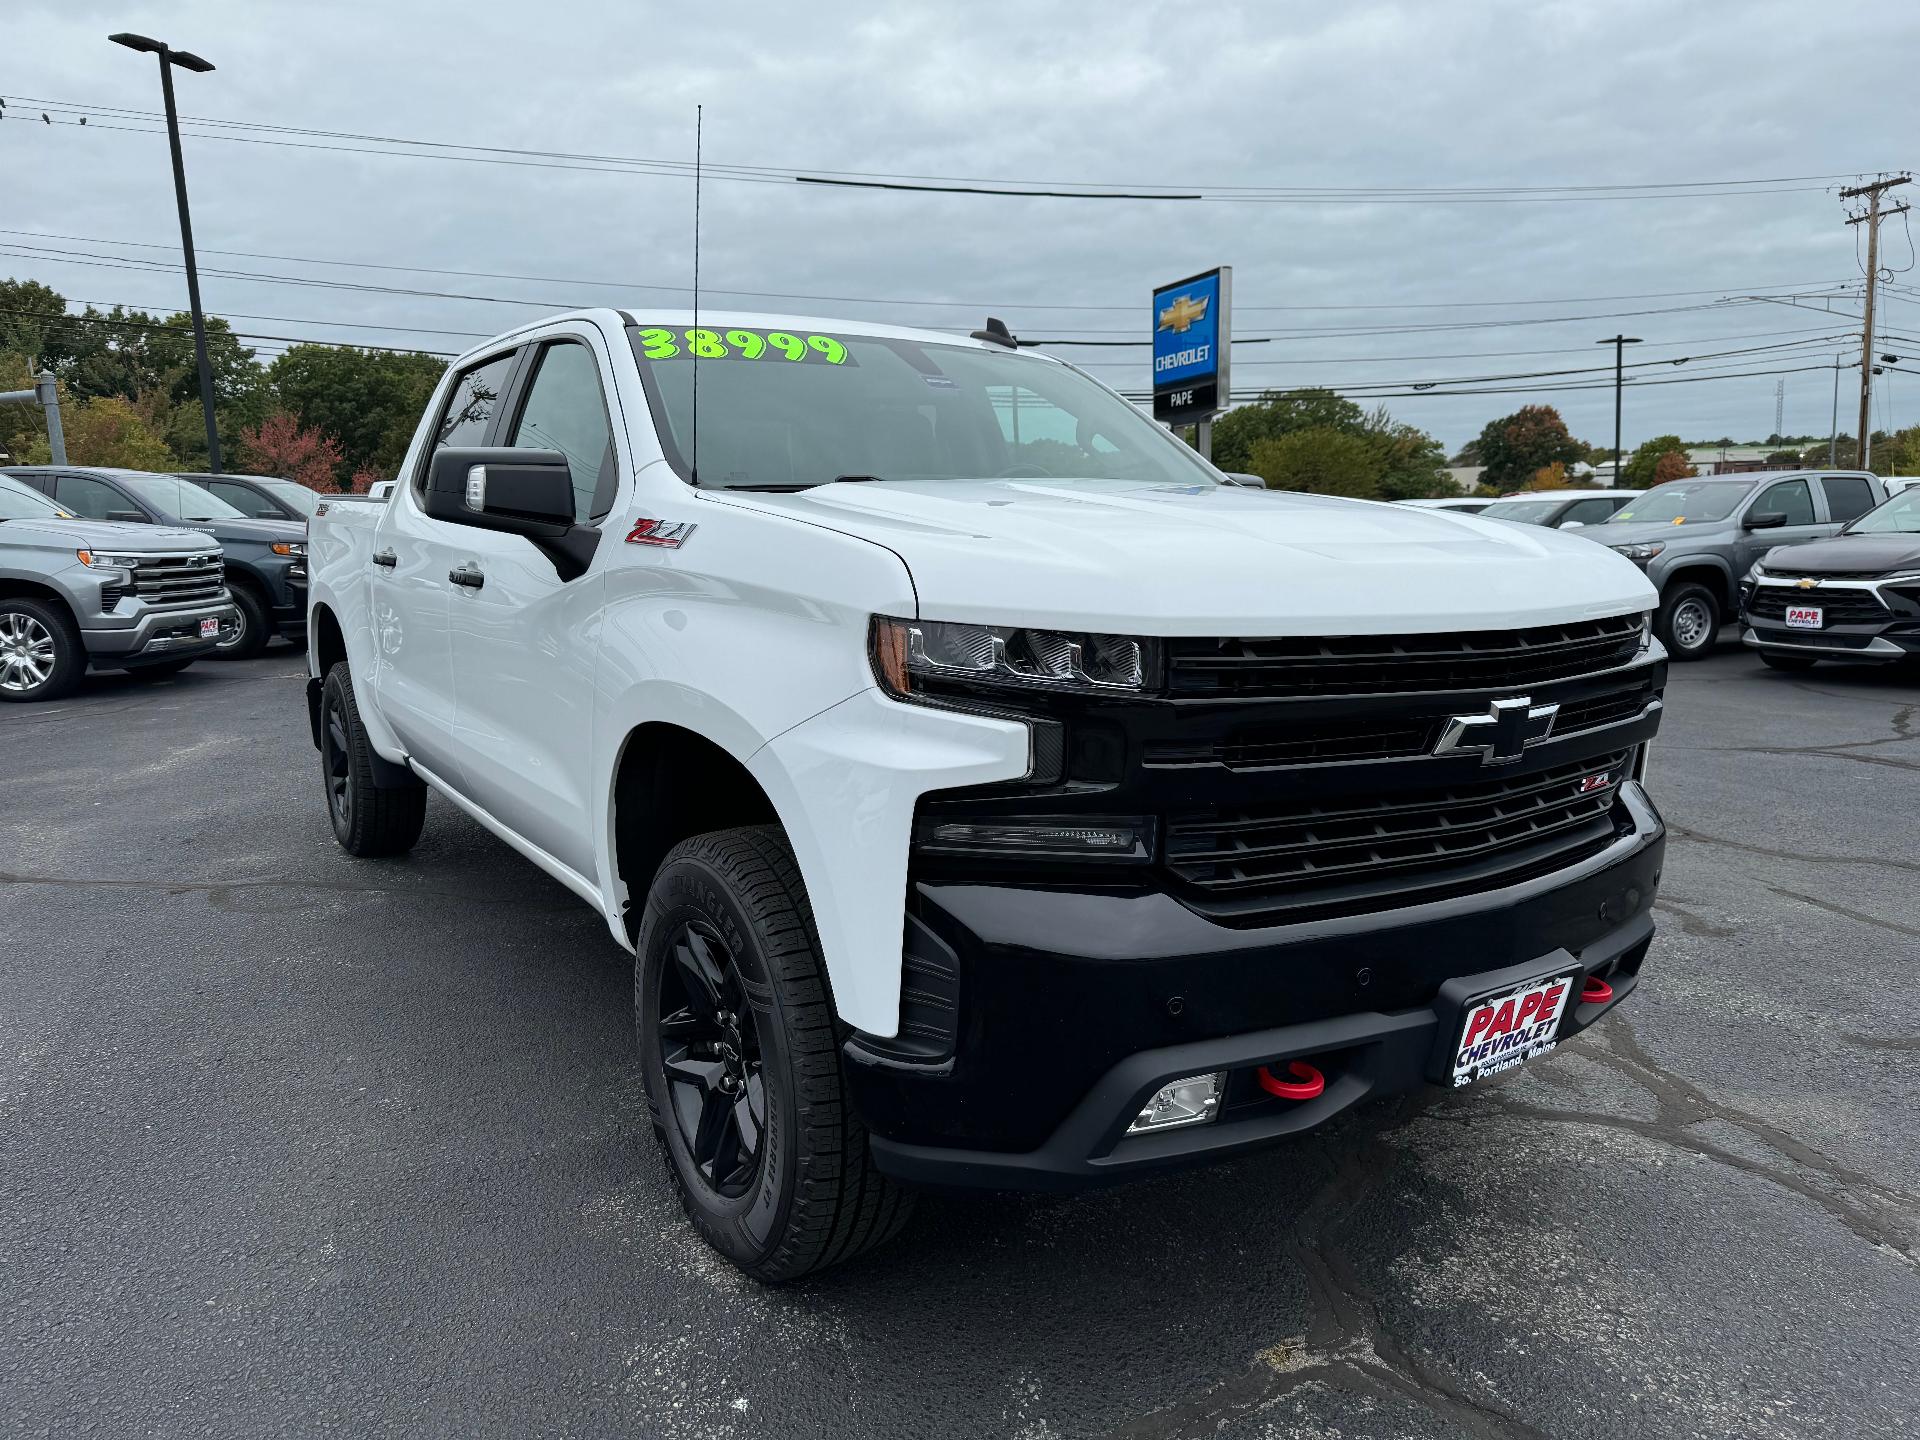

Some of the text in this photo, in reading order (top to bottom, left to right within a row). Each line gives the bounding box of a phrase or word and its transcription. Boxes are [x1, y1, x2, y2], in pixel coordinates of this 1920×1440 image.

[638, 328, 848, 365] 38999
[1155, 345, 1210, 372] CHEVROLET
[1170, 390, 1193, 407] PAPE
[1789, 610, 1819, 620] PAPE
[1463, 983, 1567, 1049] PAPE
[1456, 1018, 1558, 1069] CHEVROLET
[1454, 1075, 1472, 1088] So.
[1477, 1053, 1524, 1080] Portland,
[1527, 1041, 1557, 1060] Maine
